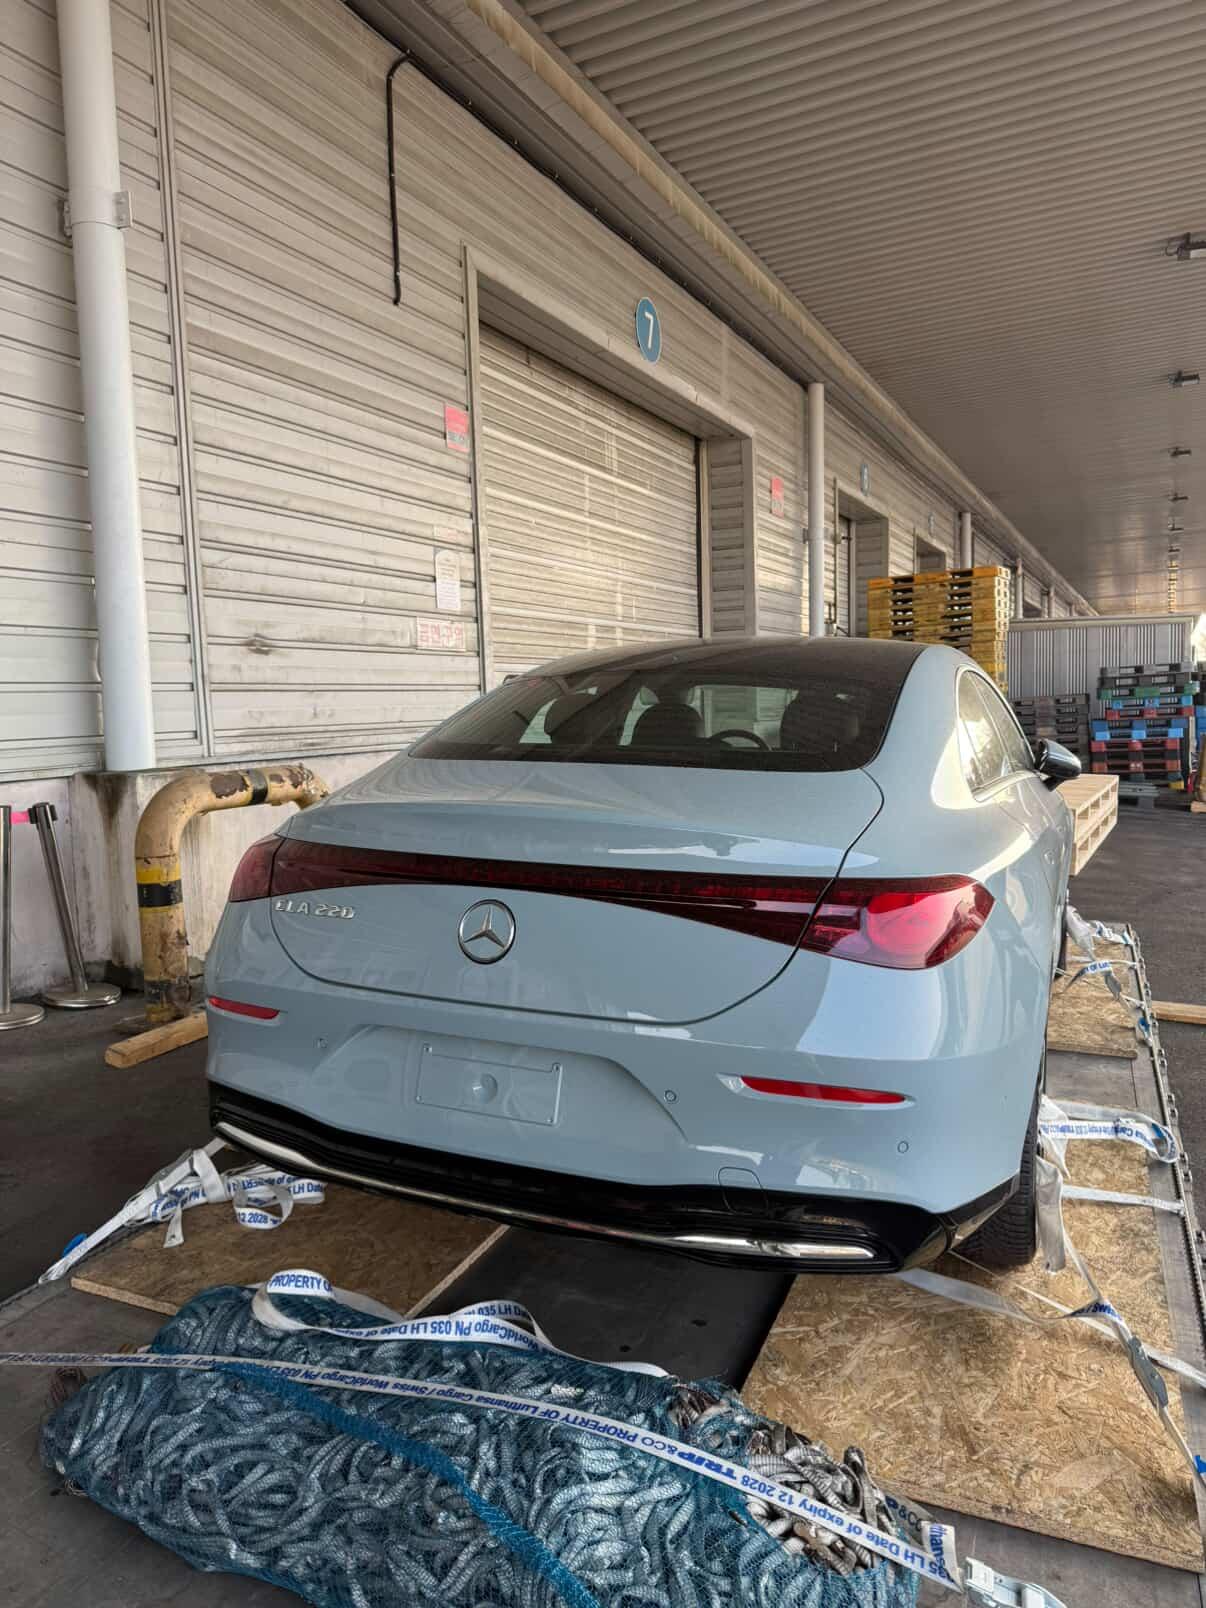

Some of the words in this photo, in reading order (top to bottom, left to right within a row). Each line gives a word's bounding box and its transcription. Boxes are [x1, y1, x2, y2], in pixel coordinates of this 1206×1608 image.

[644, 311, 654, 350] 7
[315, 904, 355, 919] 220
[247, 1212, 269, 1224] 2028
[270, 1274, 321, 1289] PROPERTY
[498, 1303, 512, 1315] LH
[382, 1324, 408, 1336] Date
[410, 1321, 428, 1334] LH
[430, 1320, 452, 1334] 035
[455, 1320, 473, 1337] PN
[475, 1319, 539, 1351] WorldCargo
[302, 1370, 319, 1381] PN
[321, 1370, 390, 1390] WorldCargo
[392, 1382, 429, 1395] Swiss
[436, 1388, 473, 1402] Cargo
[475, 1395, 540, 1416] Lufthansa
[540, 1408, 560, 1420] OF
[562, 1413, 639, 1443] PROPERTY
[641, 1436, 737, 1481] TRIP&CO
[741, 1474, 777, 1497] 2028
[778, 1490, 795, 1506] 12
[799, 1499, 845, 1527] expiry
[846, 1521, 863, 1536] of
[866, 1529, 900, 1556] Date
[904, 1548, 926, 1570] LH
